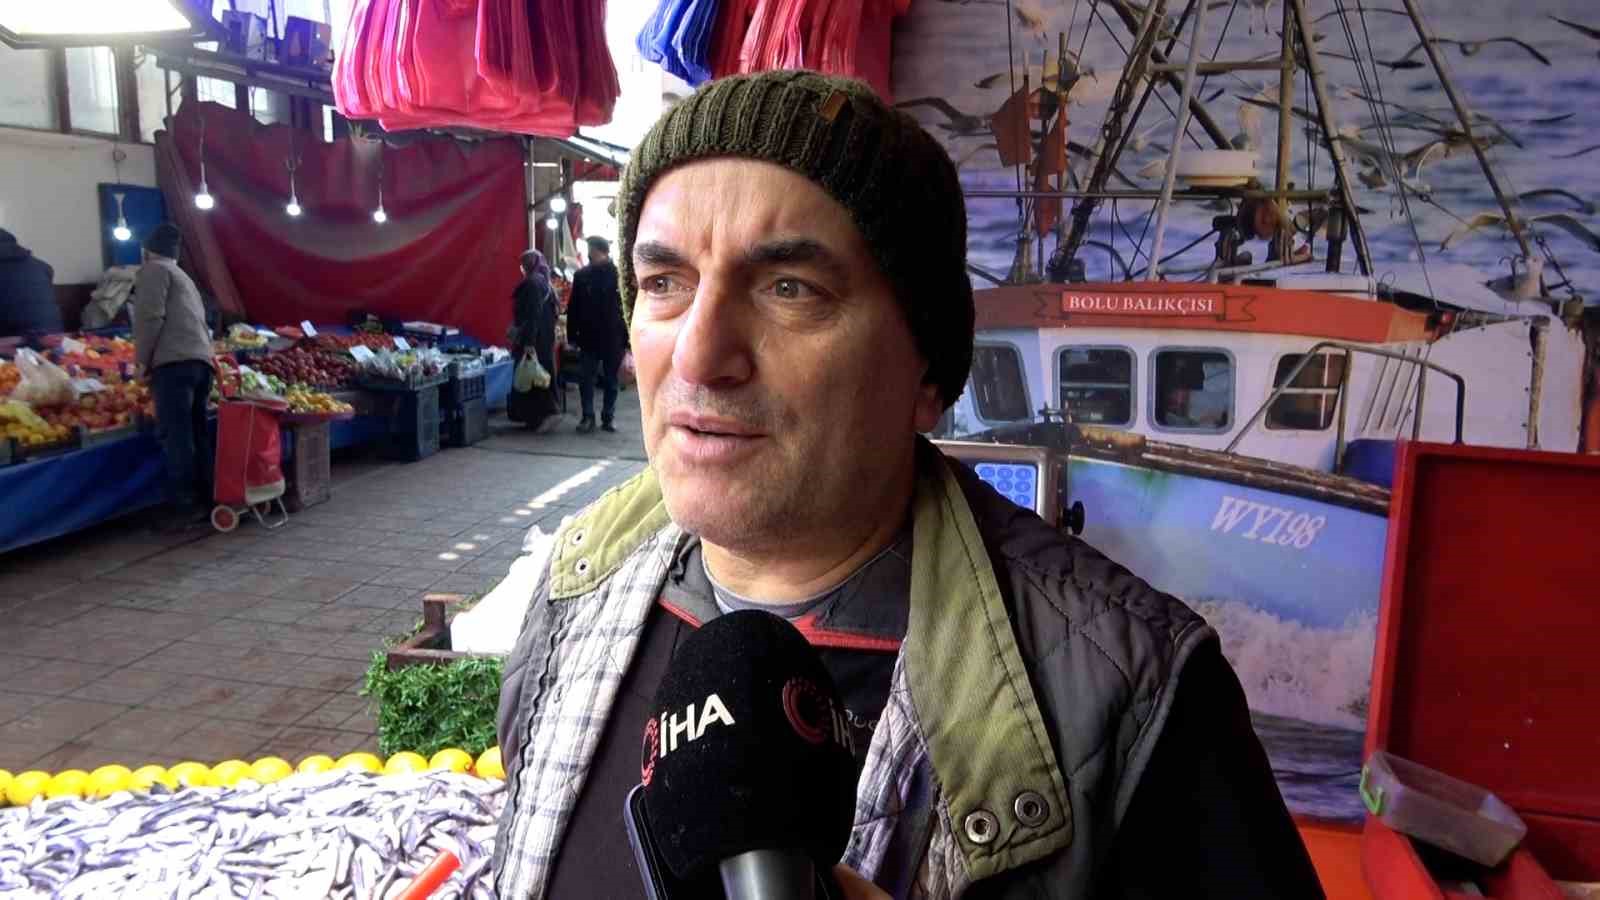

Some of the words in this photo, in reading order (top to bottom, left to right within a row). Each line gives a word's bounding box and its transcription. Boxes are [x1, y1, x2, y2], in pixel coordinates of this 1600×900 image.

[1068, 295, 1119, 311] BOLU
[1123, 296, 1214, 315] BALIKÇISI
[659, 693, 736, 758] İHA
